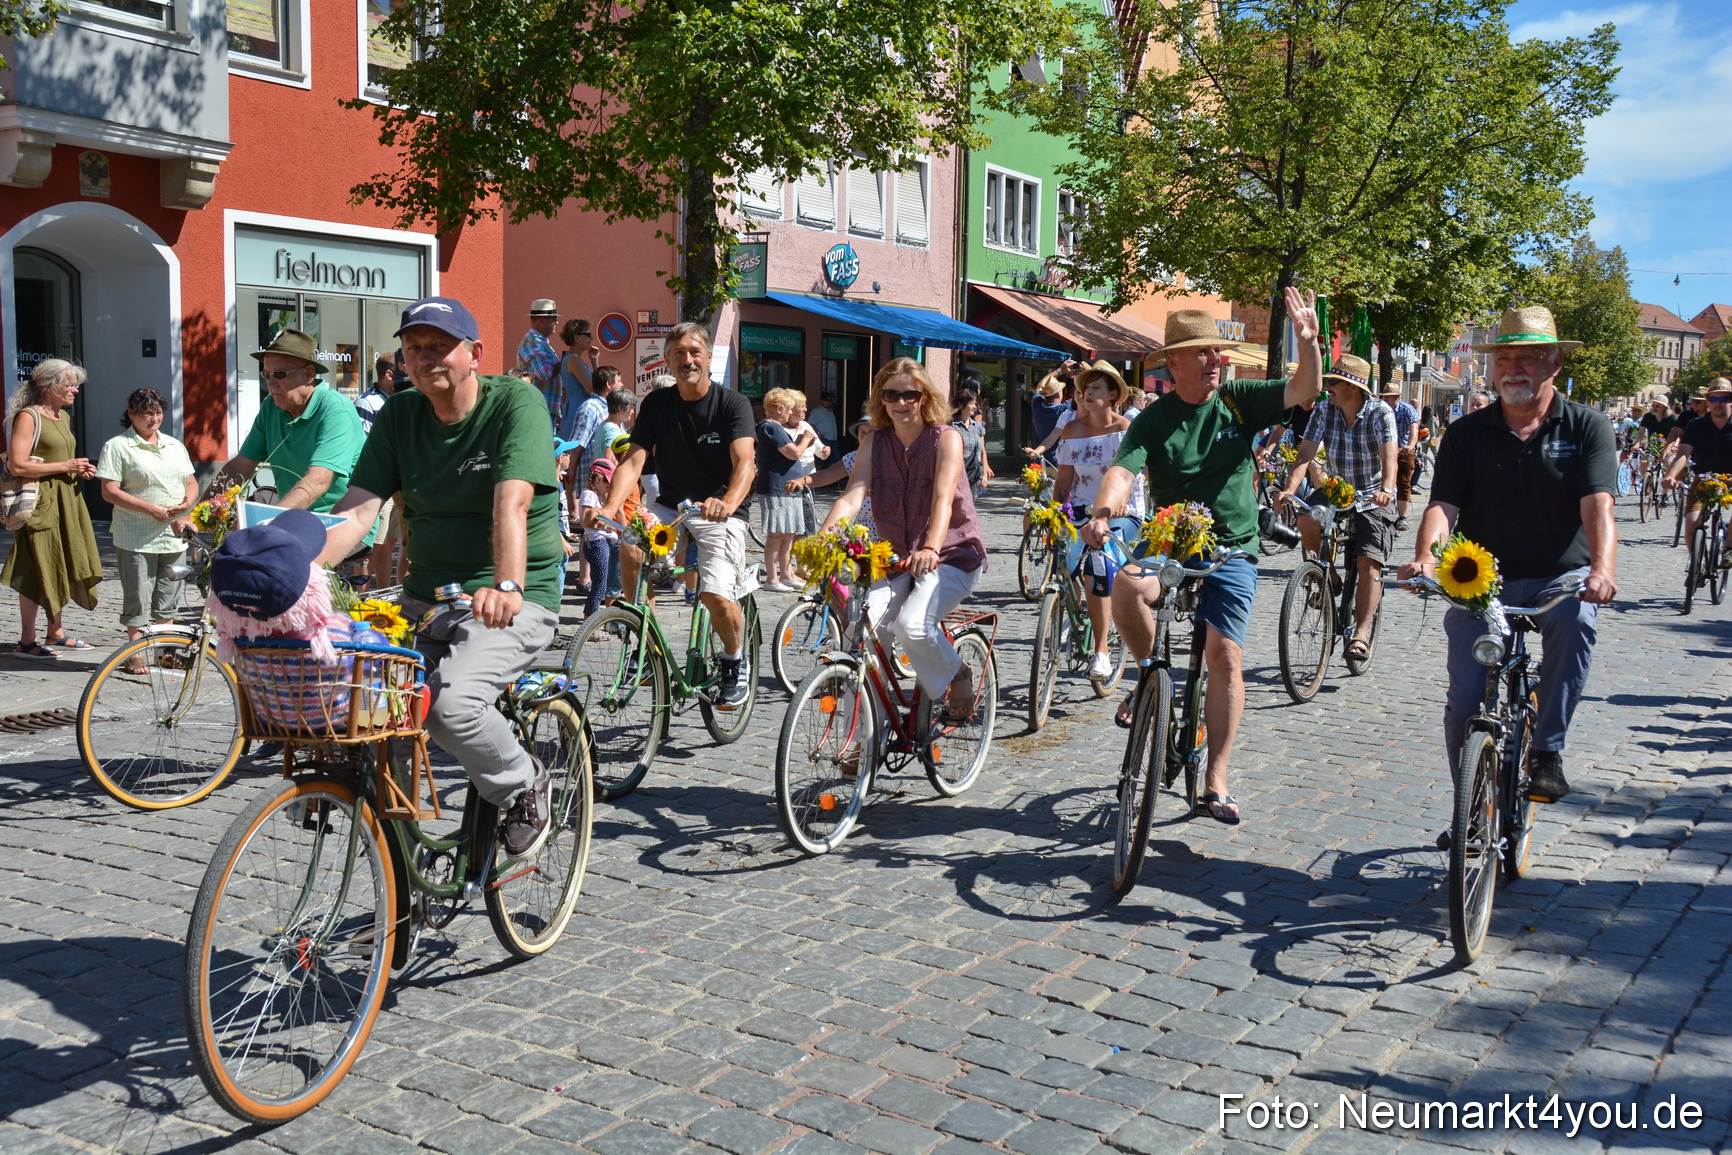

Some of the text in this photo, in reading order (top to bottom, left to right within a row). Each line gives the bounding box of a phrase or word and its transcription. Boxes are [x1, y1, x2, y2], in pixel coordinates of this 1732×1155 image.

[739, 256, 761, 273] FASS
[824, 248, 844, 264] vom
[275, 247, 386, 290] fielmann
[831, 257, 859, 281] FASS
[741, 332, 801, 350] Spirituosen Whisky
[830, 342, 853, 355] Feinkost
[232, 591, 263, 601] NEUMARKT
